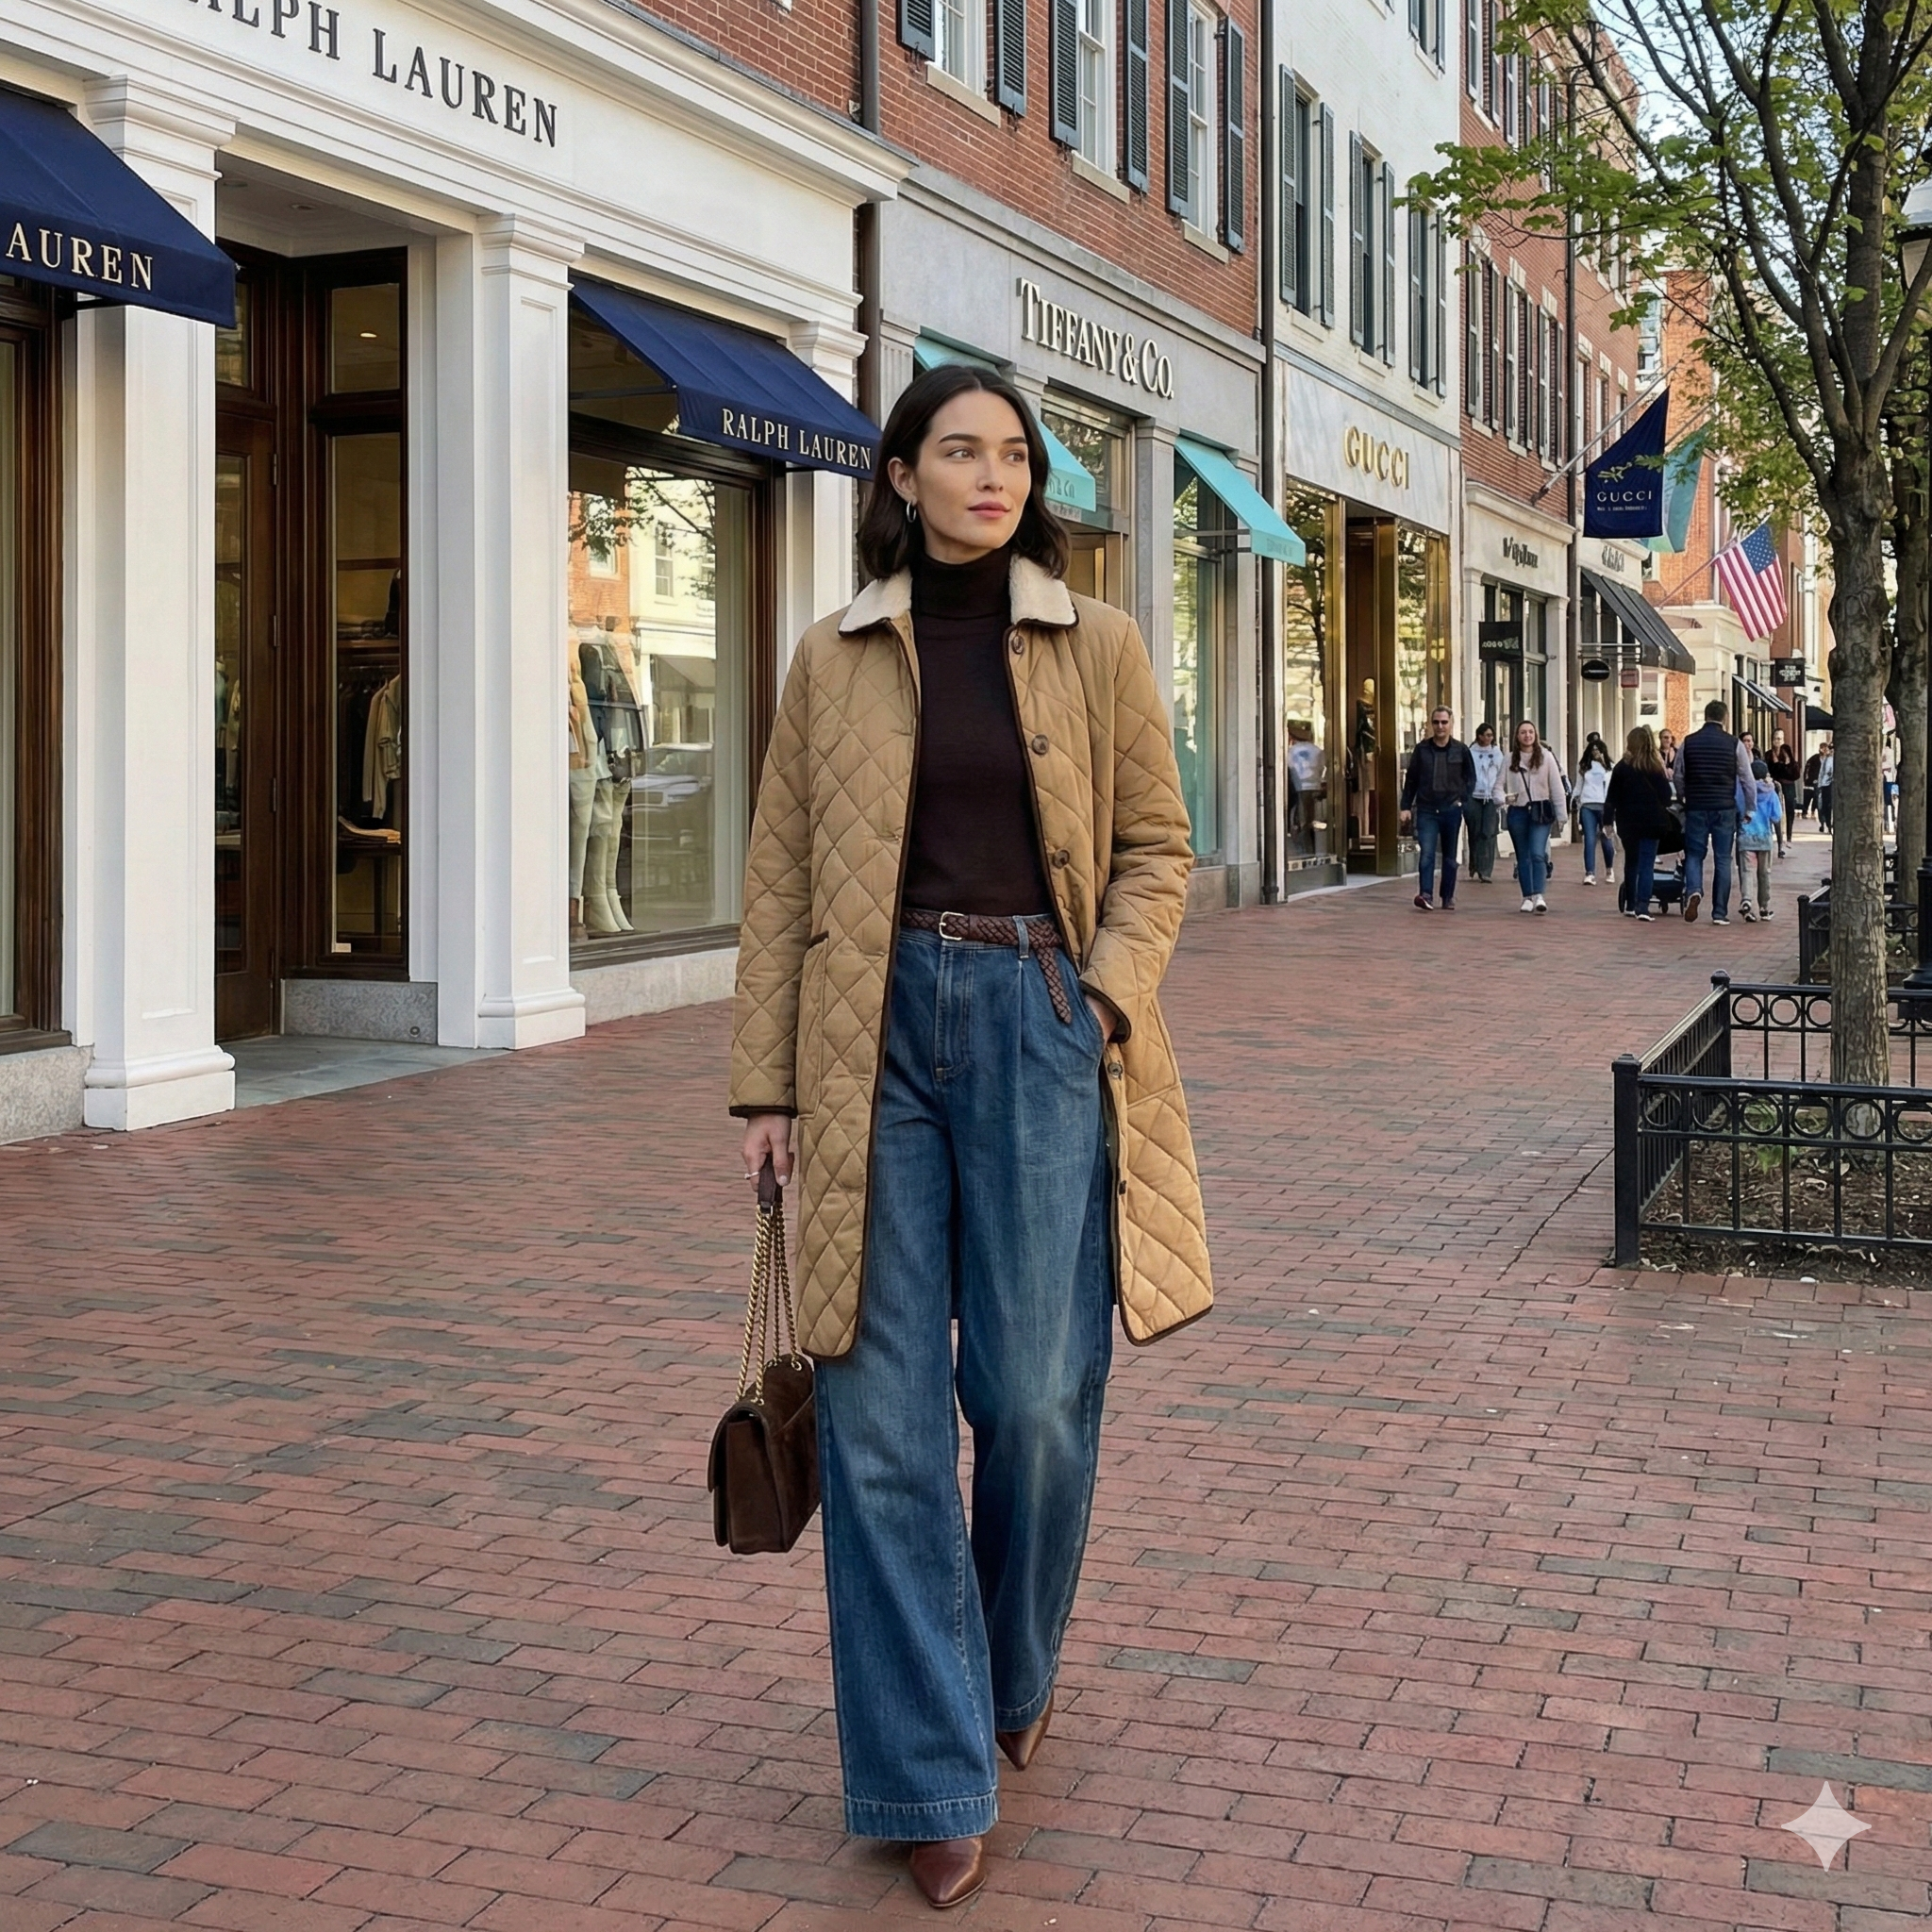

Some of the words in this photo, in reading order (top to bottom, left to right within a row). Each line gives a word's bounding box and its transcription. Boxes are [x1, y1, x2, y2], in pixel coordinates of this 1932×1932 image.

[372, 27, 558, 148] LAUREN
[5, 222, 153, 291] AUREN
[722, 408, 790, 451] RALPH
[799, 429, 872, 471] LAUREN
[1344, 425, 1410, 491] GUCCI
[1596, 490, 1653, 503] GUCCI
